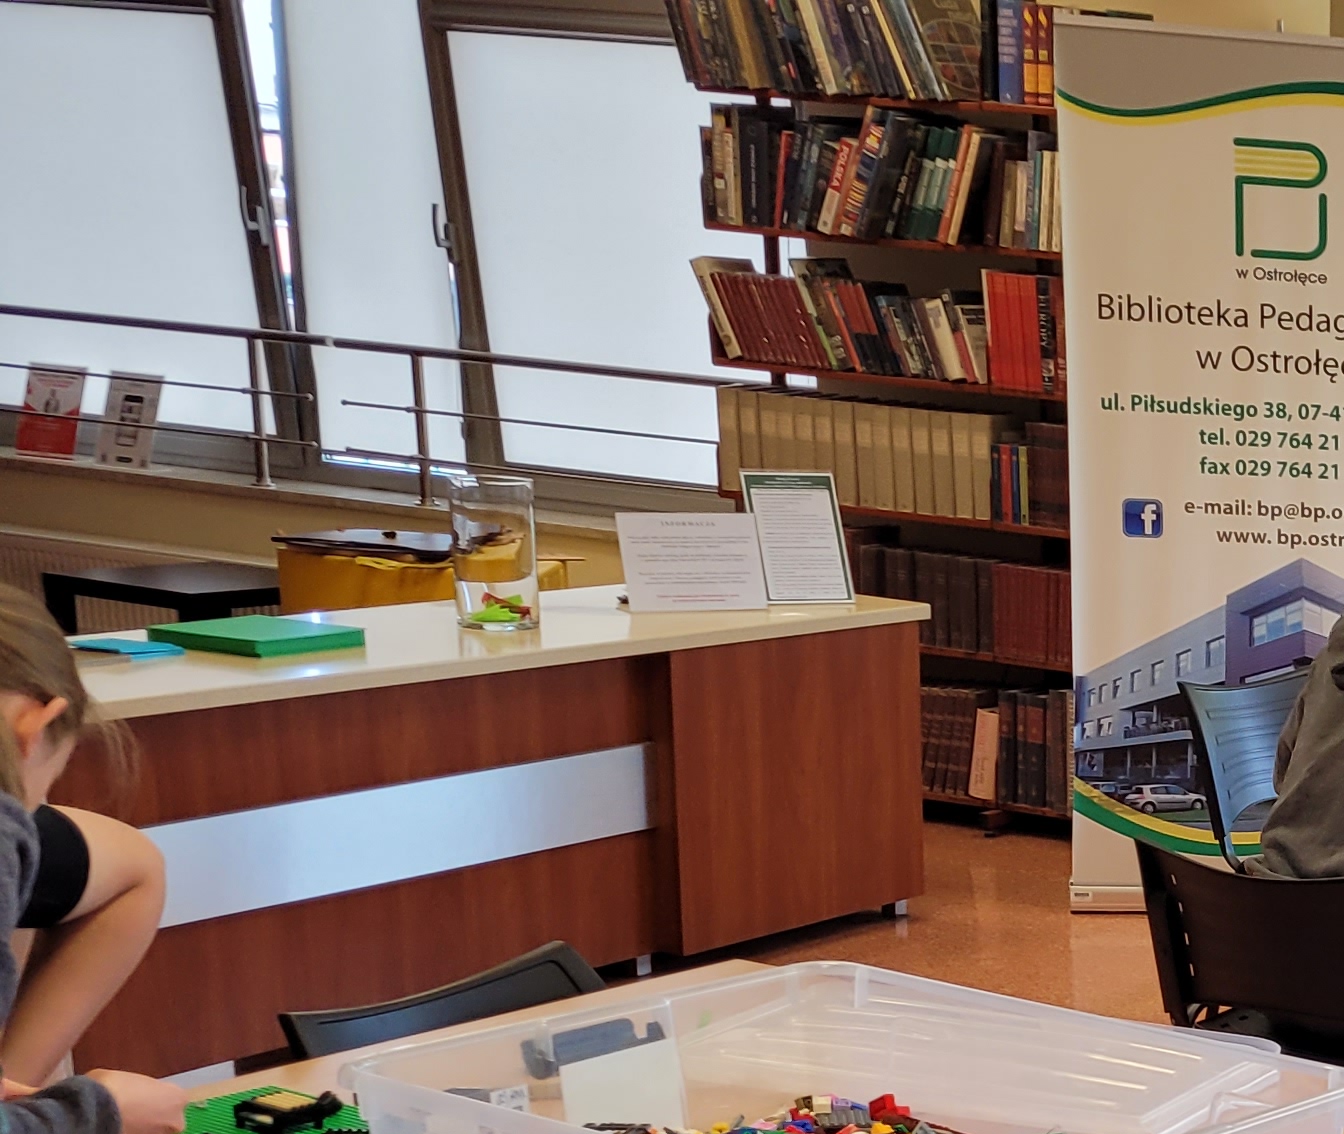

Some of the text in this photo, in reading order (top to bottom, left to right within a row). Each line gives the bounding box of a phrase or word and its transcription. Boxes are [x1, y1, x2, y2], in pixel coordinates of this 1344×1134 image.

[1235, 266, 1328, 287] w Ostrołęce
[1097, 293, 1249, 328] Biblioteka
[1195, 349, 1222, 370] w
[1100, 392, 1125, 412] ul.
[1130, 394, 1258, 422] Piłsudskiego
[1263, 401, 1292, 422] 38,
[1199, 427, 1230, 446] tel.
[1235, 429, 1272, 448] 029
[1276, 431, 1313, 450] 764
[1318, 433, 1339, 451] 21
[1199, 456, 1230, 475] fax
[1235, 459, 1272, 477] 029
[1276, 461, 1313, 479] 764
[1317, 463, 1338, 480] 21
[1184, 499, 1252, 516] e-mail:
[1216, 530, 1272, 545] www.
